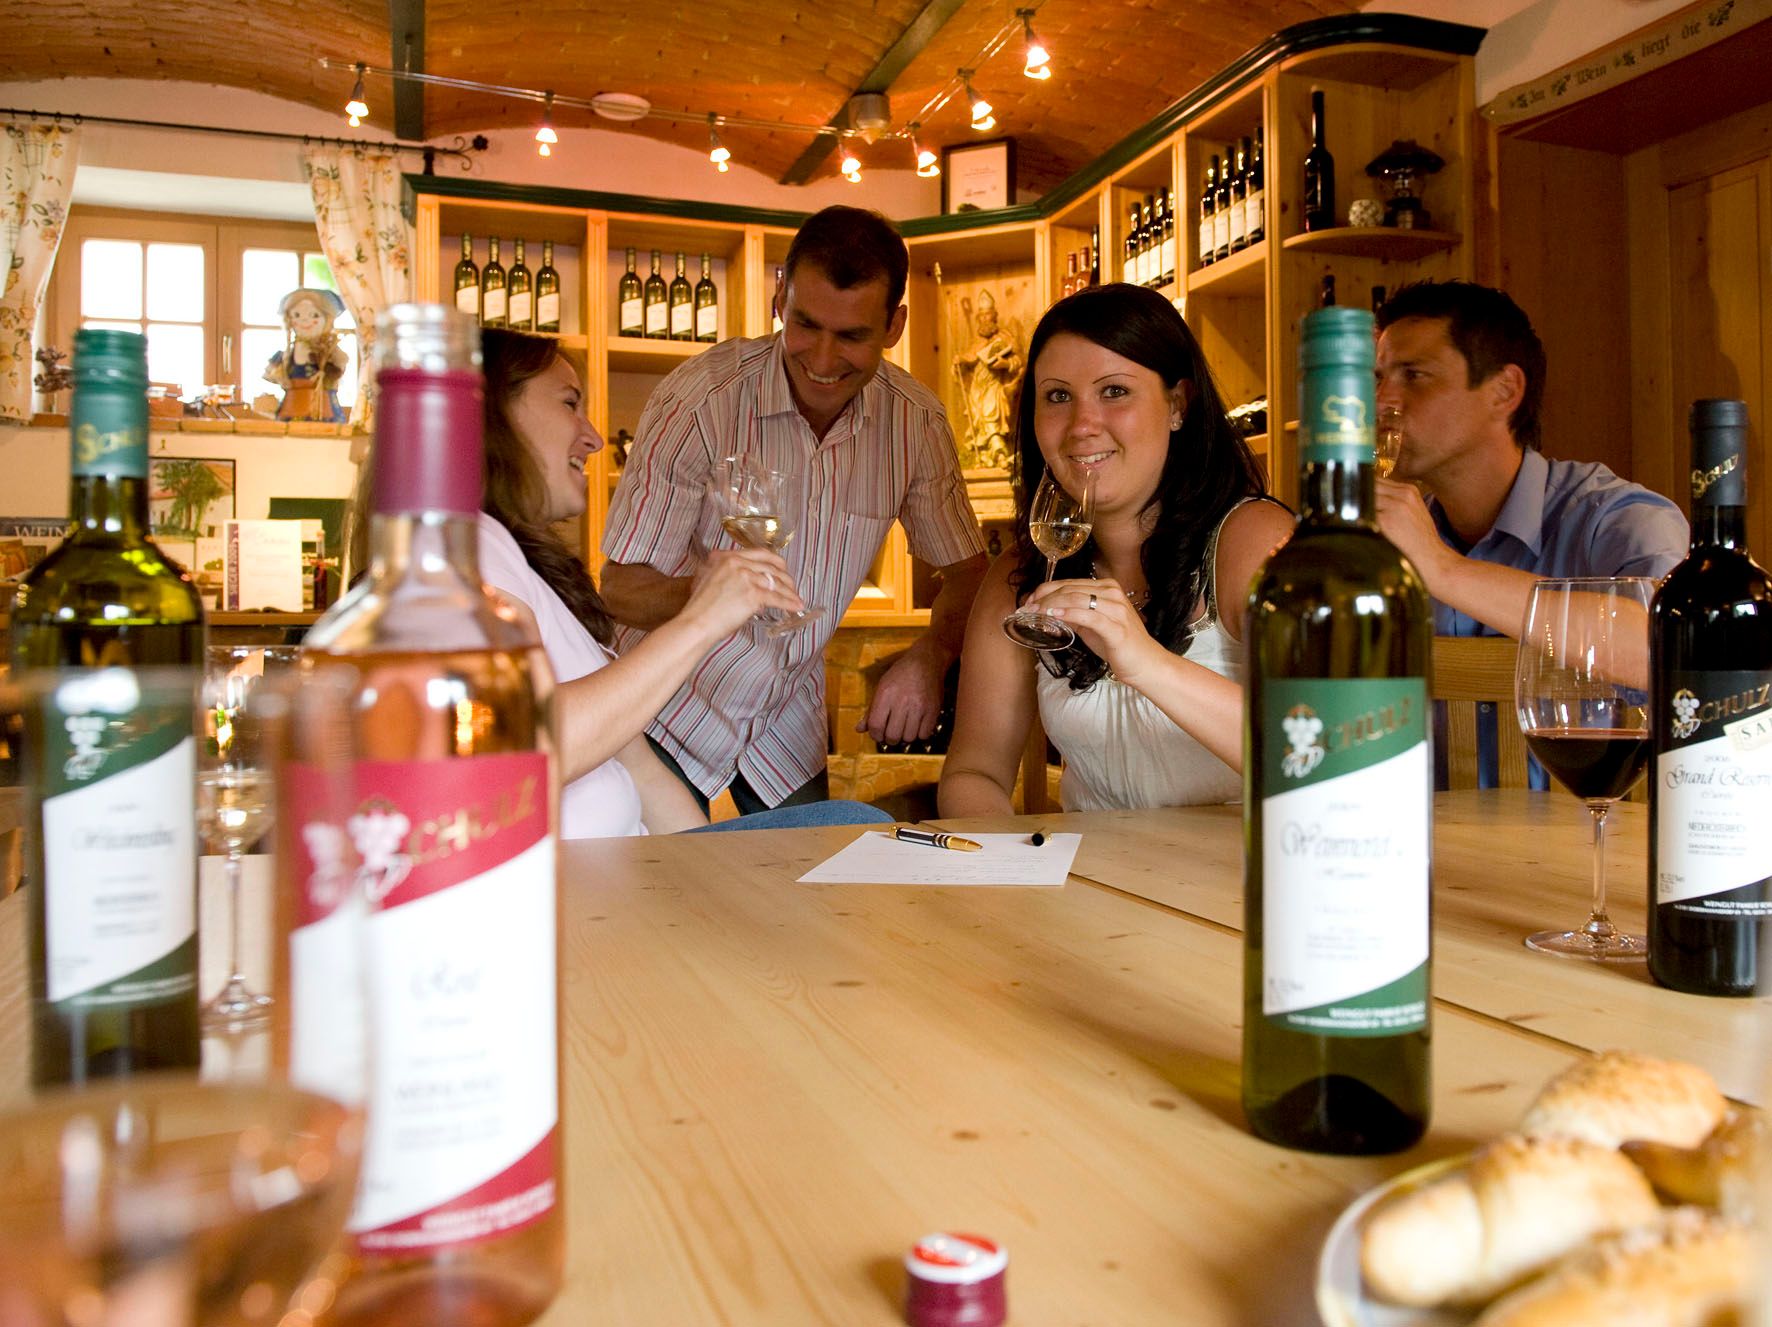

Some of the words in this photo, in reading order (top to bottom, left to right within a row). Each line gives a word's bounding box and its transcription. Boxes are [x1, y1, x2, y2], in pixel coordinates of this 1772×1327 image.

[1575, 65, 1607, 85] Wein
[1641, 34, 1670, 57] liegt
[1681, 20, 1701, 39] die
[1665, 764, 1716, 789] Grand
